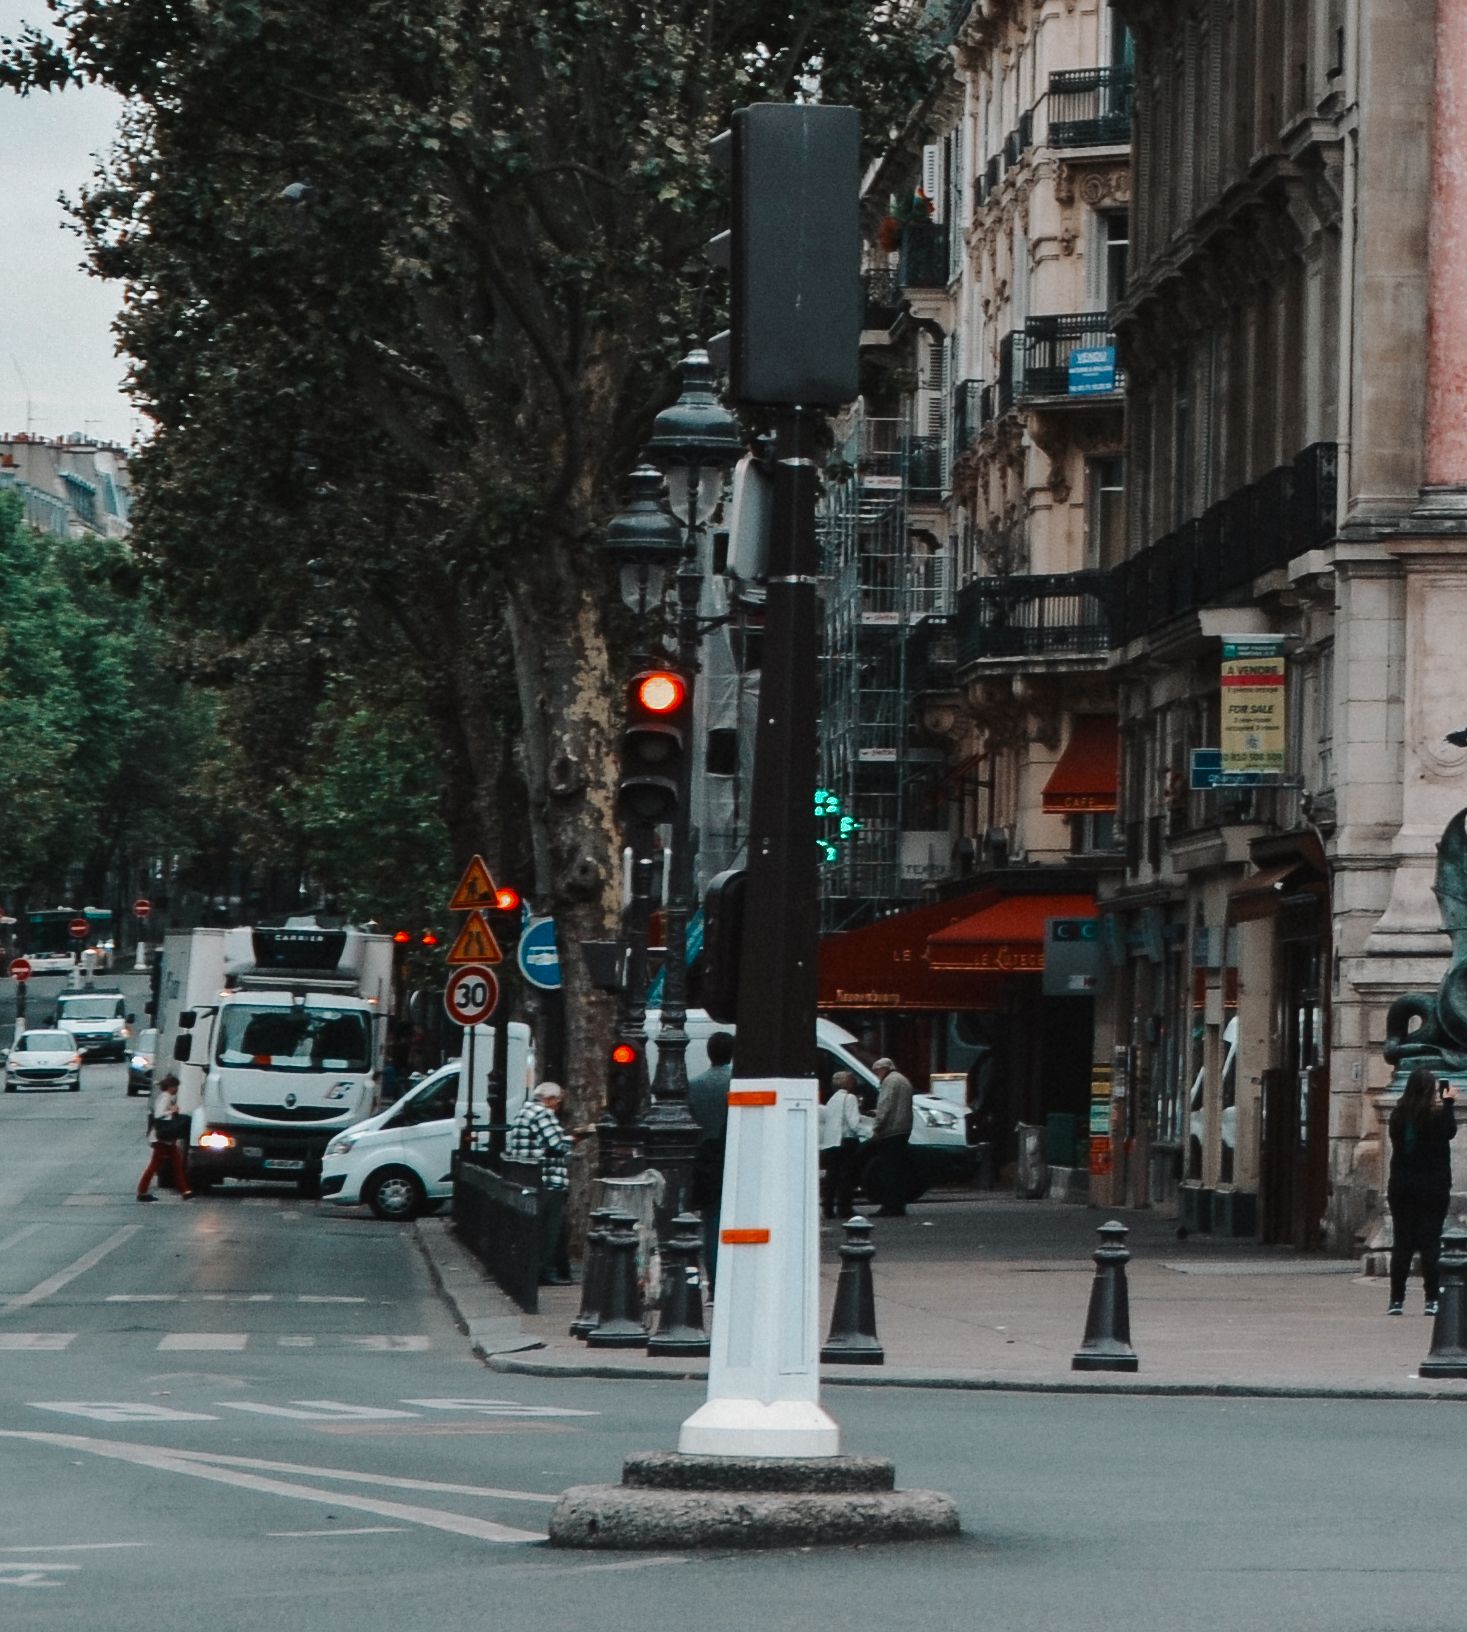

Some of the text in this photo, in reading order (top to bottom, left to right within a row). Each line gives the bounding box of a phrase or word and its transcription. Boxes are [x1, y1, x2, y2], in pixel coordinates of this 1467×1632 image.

[1237, 665, 1279, 675] VENDRE
[1228, 704, 1274, 714] FOR SALE
[455, 982, 487, 1009] 30
